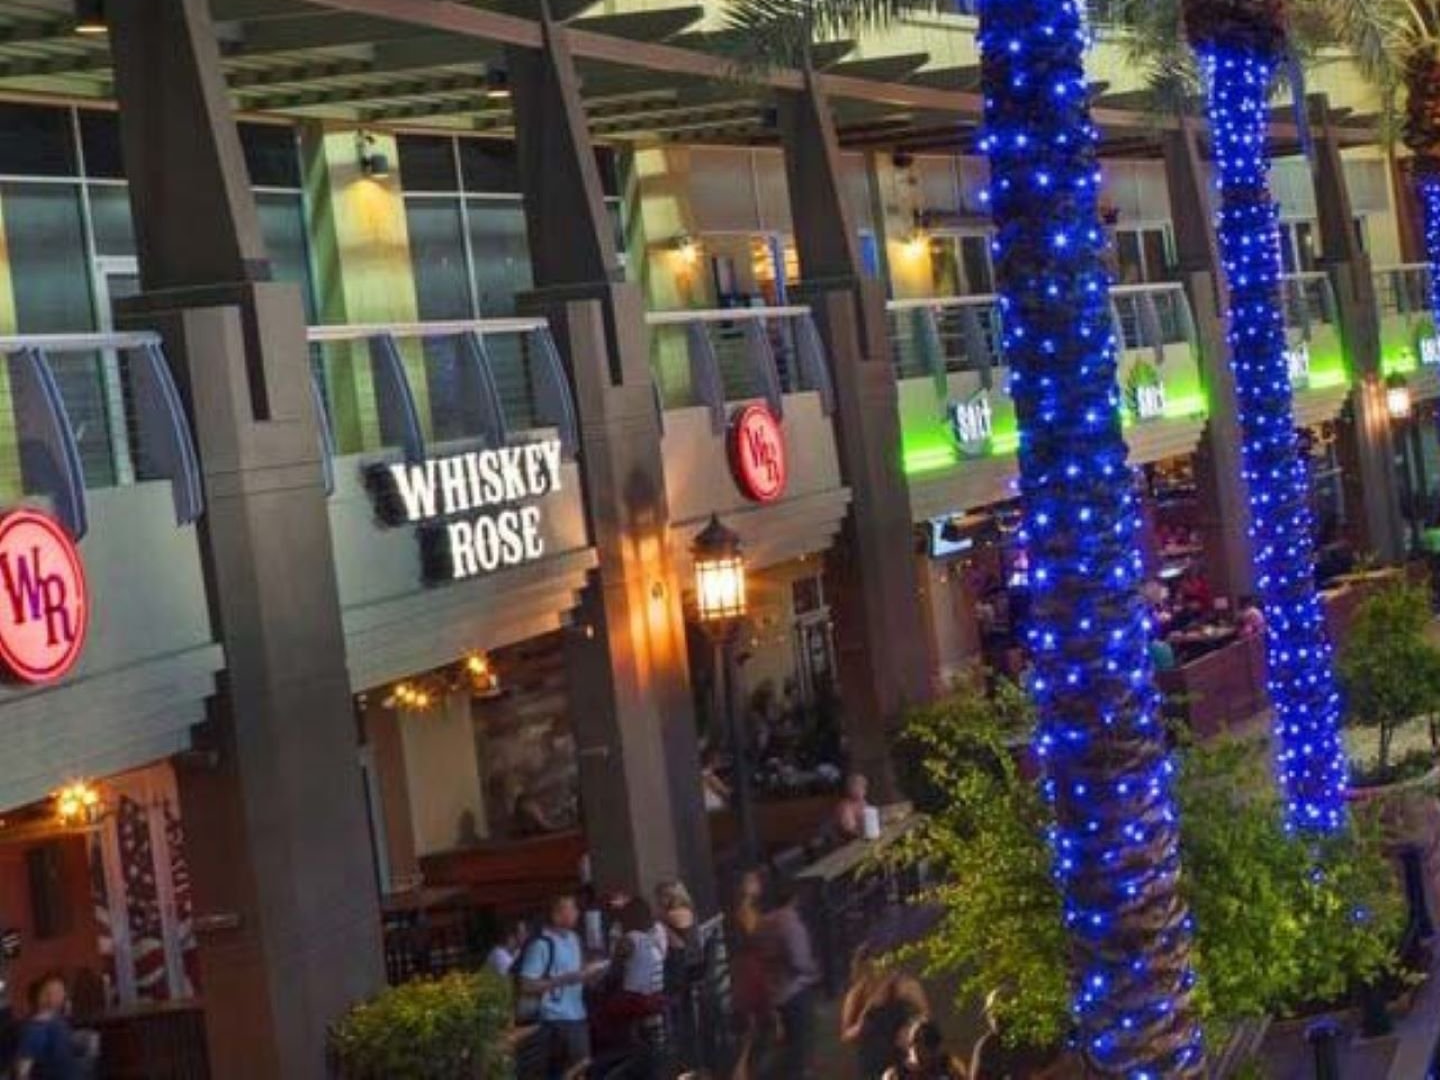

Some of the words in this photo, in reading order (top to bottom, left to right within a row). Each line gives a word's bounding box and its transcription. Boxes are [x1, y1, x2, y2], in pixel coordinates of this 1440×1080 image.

[391, 439, 562, 521] WHISKEY
[448, 506, 543, 578] ROSE
[0, 546, 75, 646] WR
